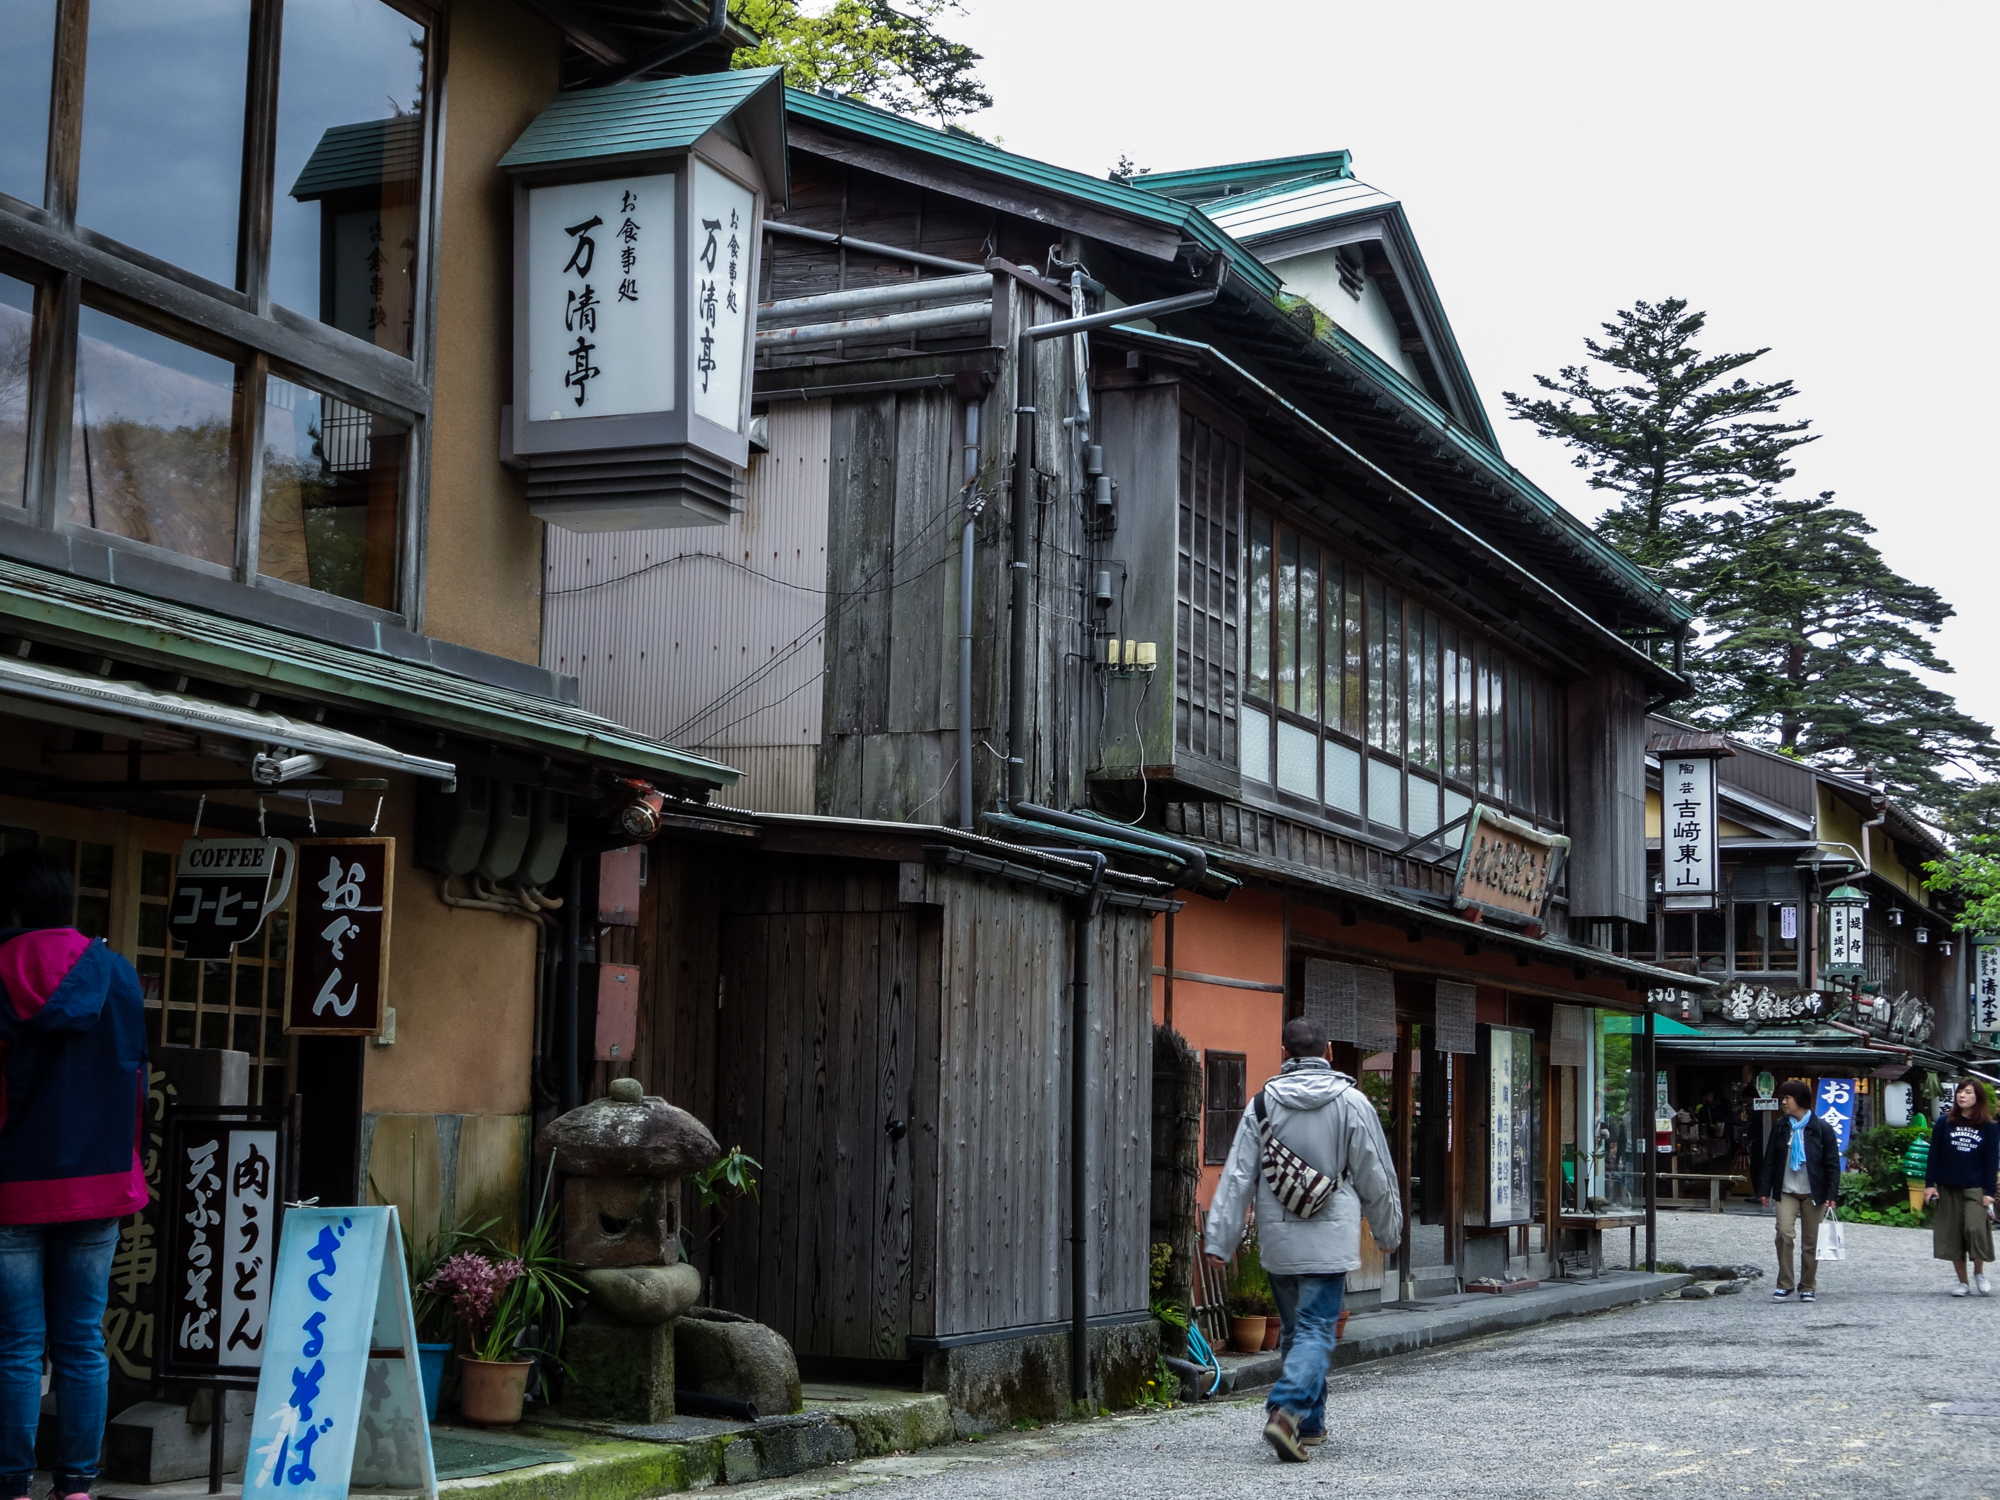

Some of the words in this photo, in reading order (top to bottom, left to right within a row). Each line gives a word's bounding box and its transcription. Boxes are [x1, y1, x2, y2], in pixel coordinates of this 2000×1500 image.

[616, 190, 641, 303] お食事処
[726, 208, 740, 314] お食事処
[563, 215, 604, 407] 万清亭
[697, 218, 722, 394] 万清亭
[1678, 763, 1695, 794] 陶芸
[173, 886, 258, 926] コーヒー
[189, 847, 265, 868] COFFEE
[312, 856, 366, 1016] おでん
[1850, 916, 1862, 953] 堤亭
[1981, 977, 1998, 1028] 清水亭
[179, 1139, 222, 1351] 天ぷらそば
[227, 1142, 271, 1351] 肉うどん
[272, 1216, 353, 1487] ざるそば
